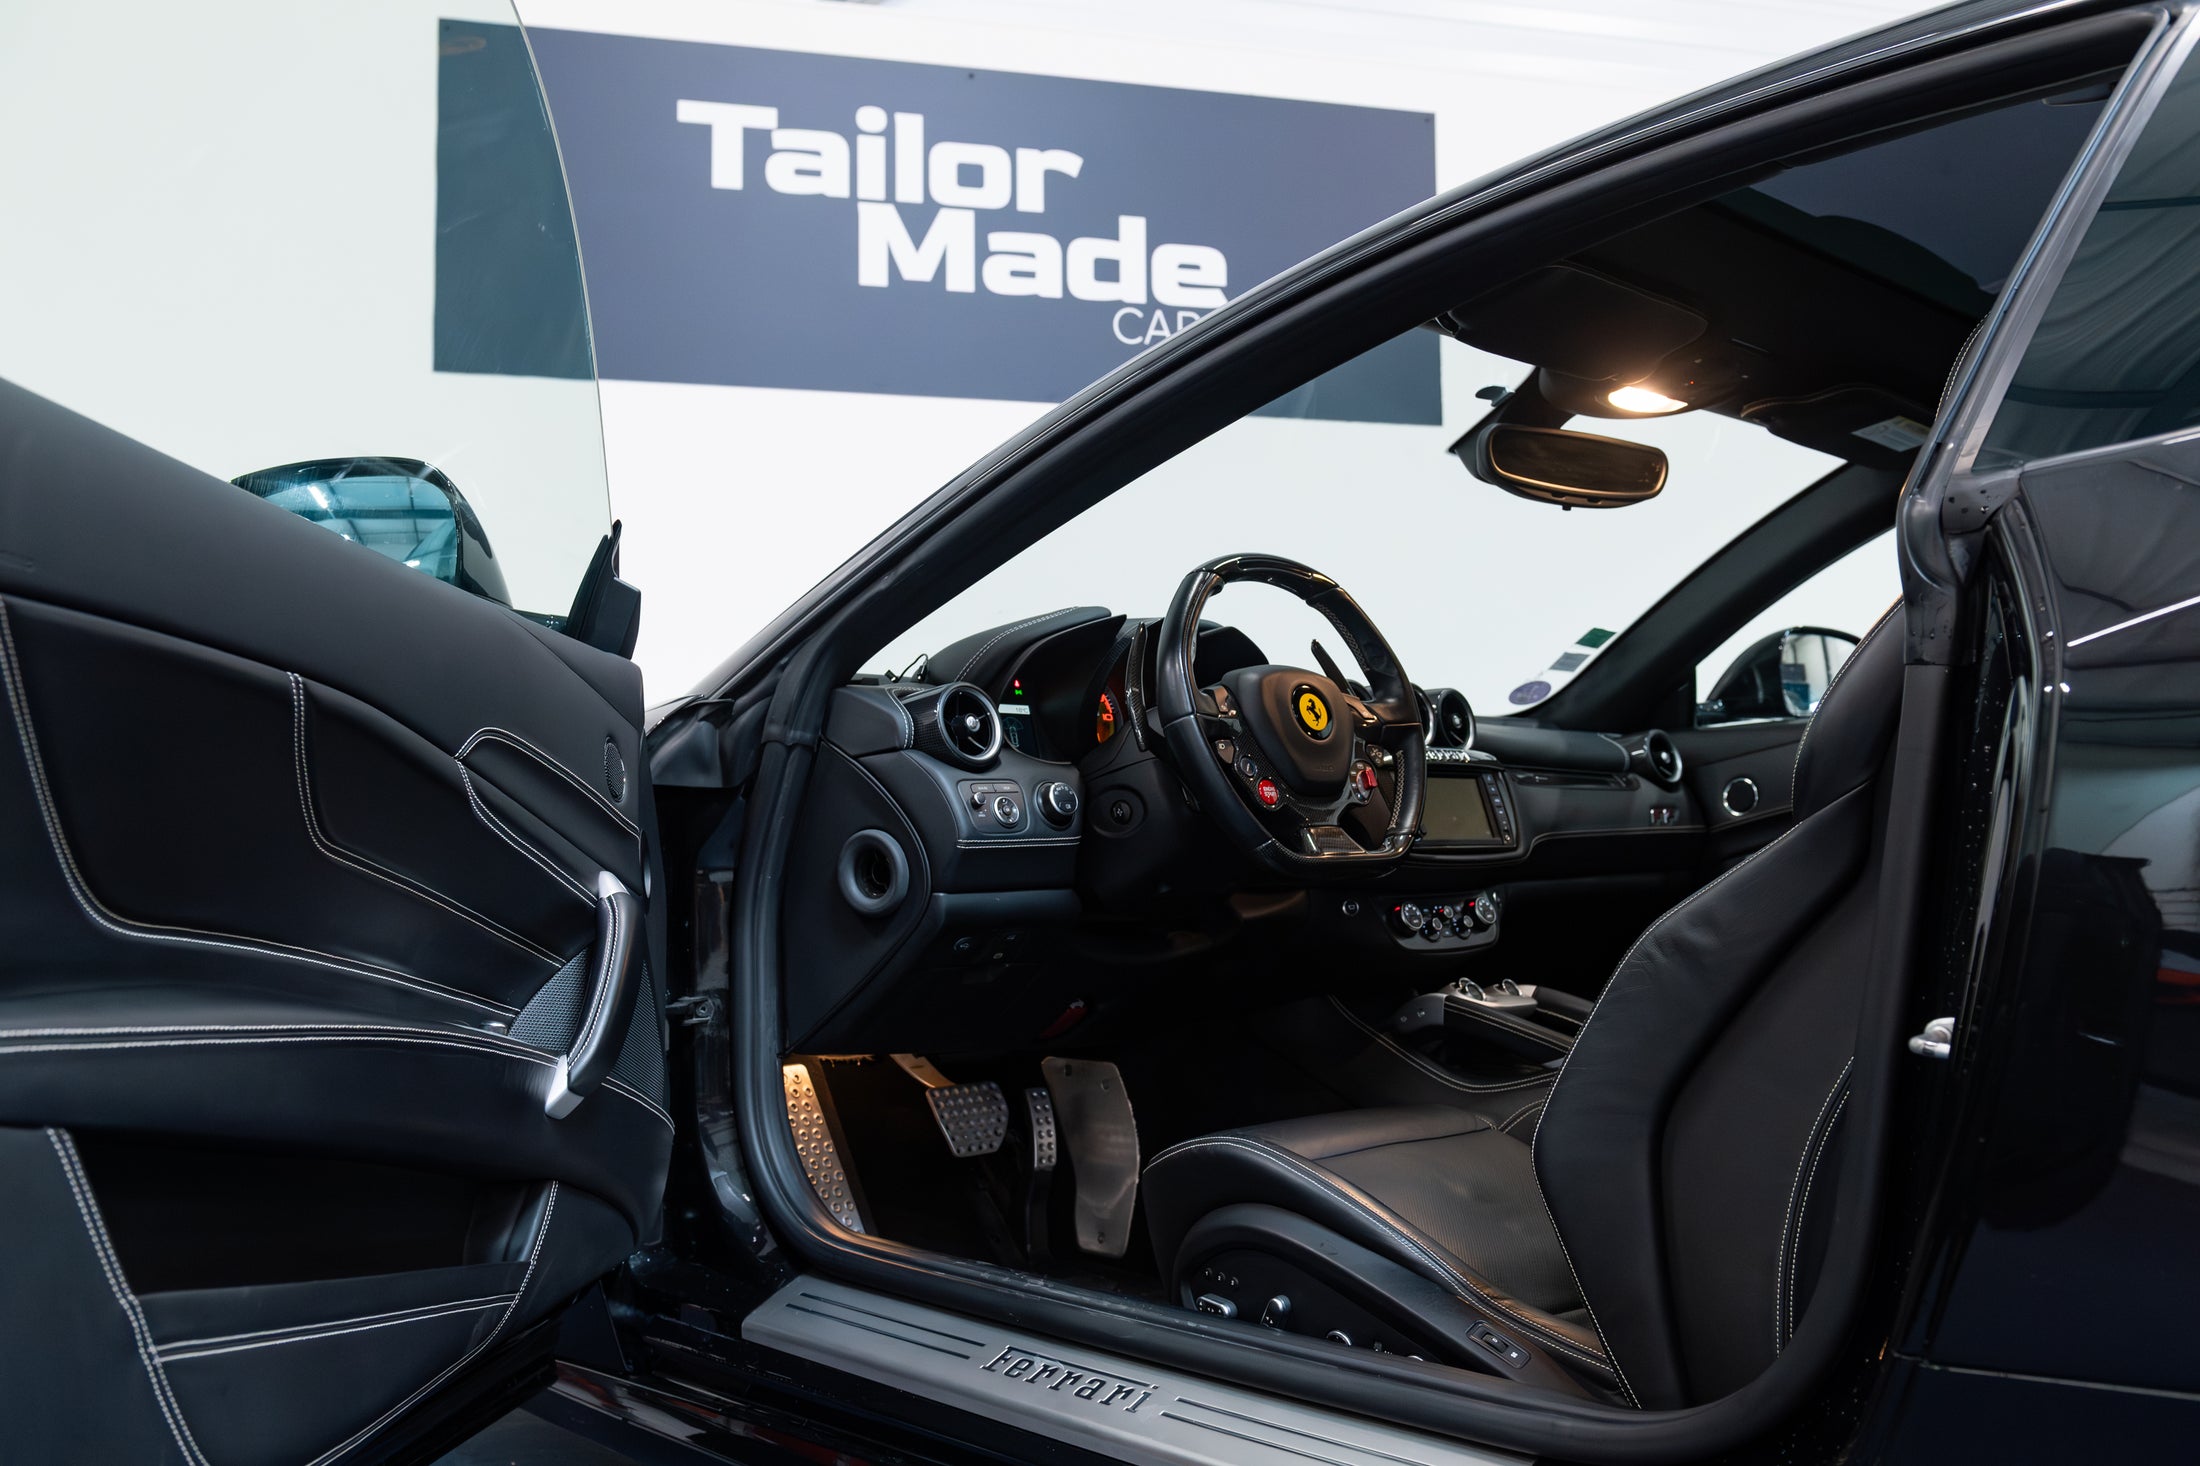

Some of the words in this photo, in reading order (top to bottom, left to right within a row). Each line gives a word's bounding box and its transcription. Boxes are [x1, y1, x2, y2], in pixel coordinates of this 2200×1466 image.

[677, 99, 1084, 214] Tailor
[856, 200, 1229, 310] Made
[980, 1344, 1160, 1414] Ferrari
